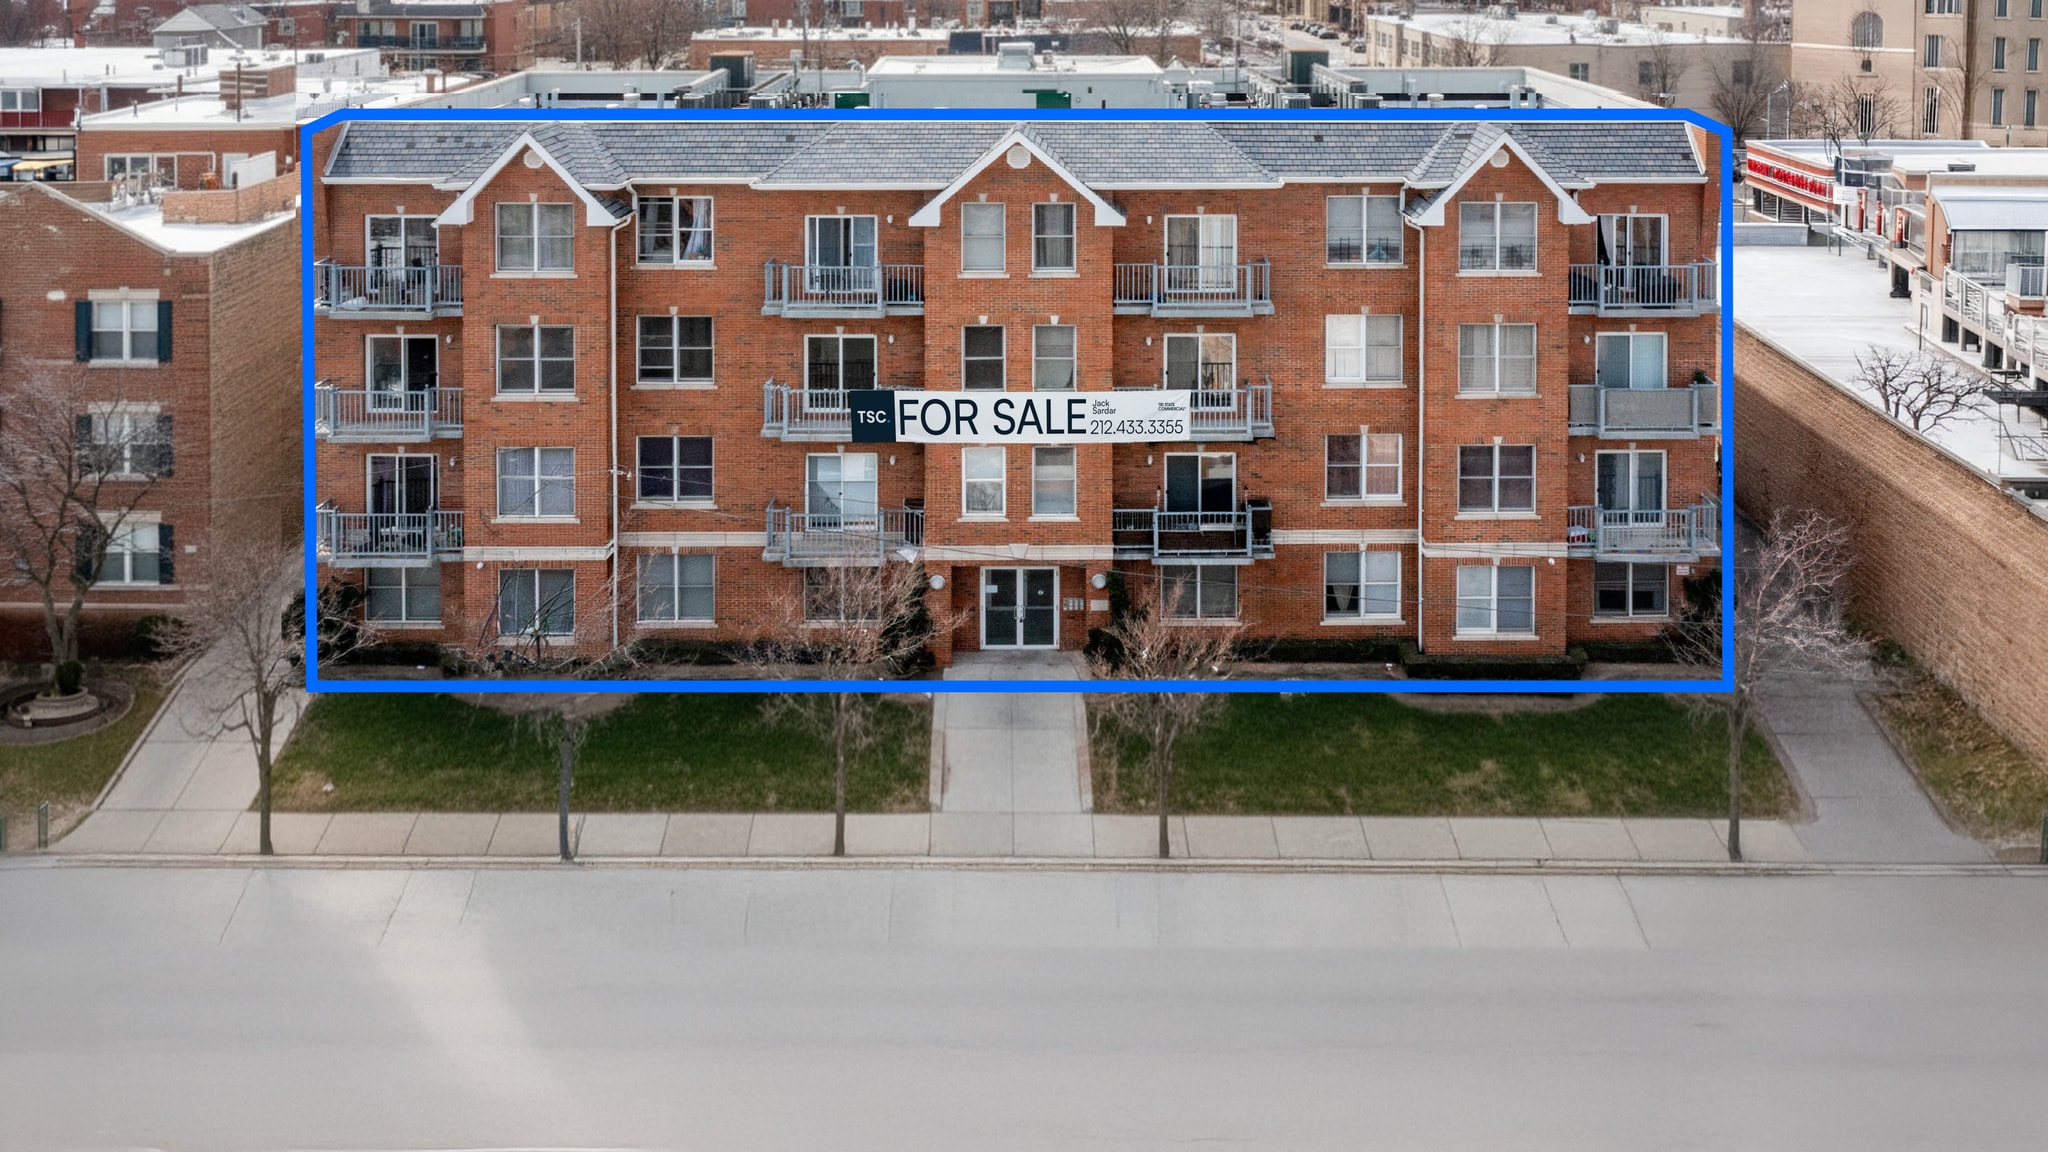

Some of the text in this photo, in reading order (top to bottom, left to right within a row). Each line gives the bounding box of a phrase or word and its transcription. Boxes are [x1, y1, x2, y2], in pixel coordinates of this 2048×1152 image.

[1092, 399, 1110, 407] Jack
[1092, 406, 1117, 415] Sardar
[898, 398, 1087, 436] FOR SALE
[1090, 419, 1183, 434] 212.433.3355
